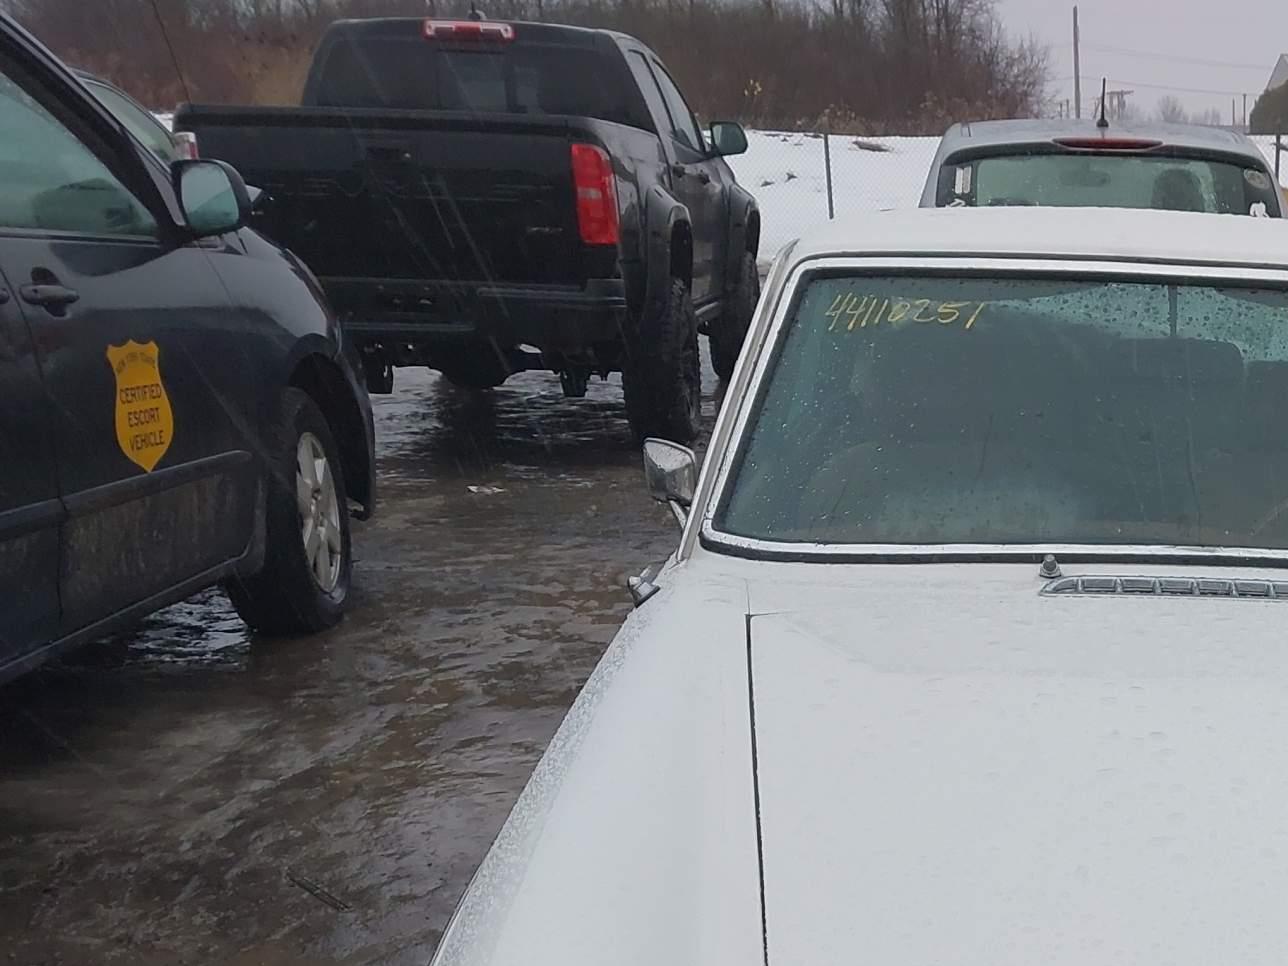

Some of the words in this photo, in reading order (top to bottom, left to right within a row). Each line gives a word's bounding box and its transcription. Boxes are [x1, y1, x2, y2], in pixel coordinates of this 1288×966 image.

[825, 293, 985, 331] 44110251
[120, 383, 162, 405] CERTIFIED
[127, 407, 160, 428] ESCORT
[130, 430, 165, 451] VEHICLE
